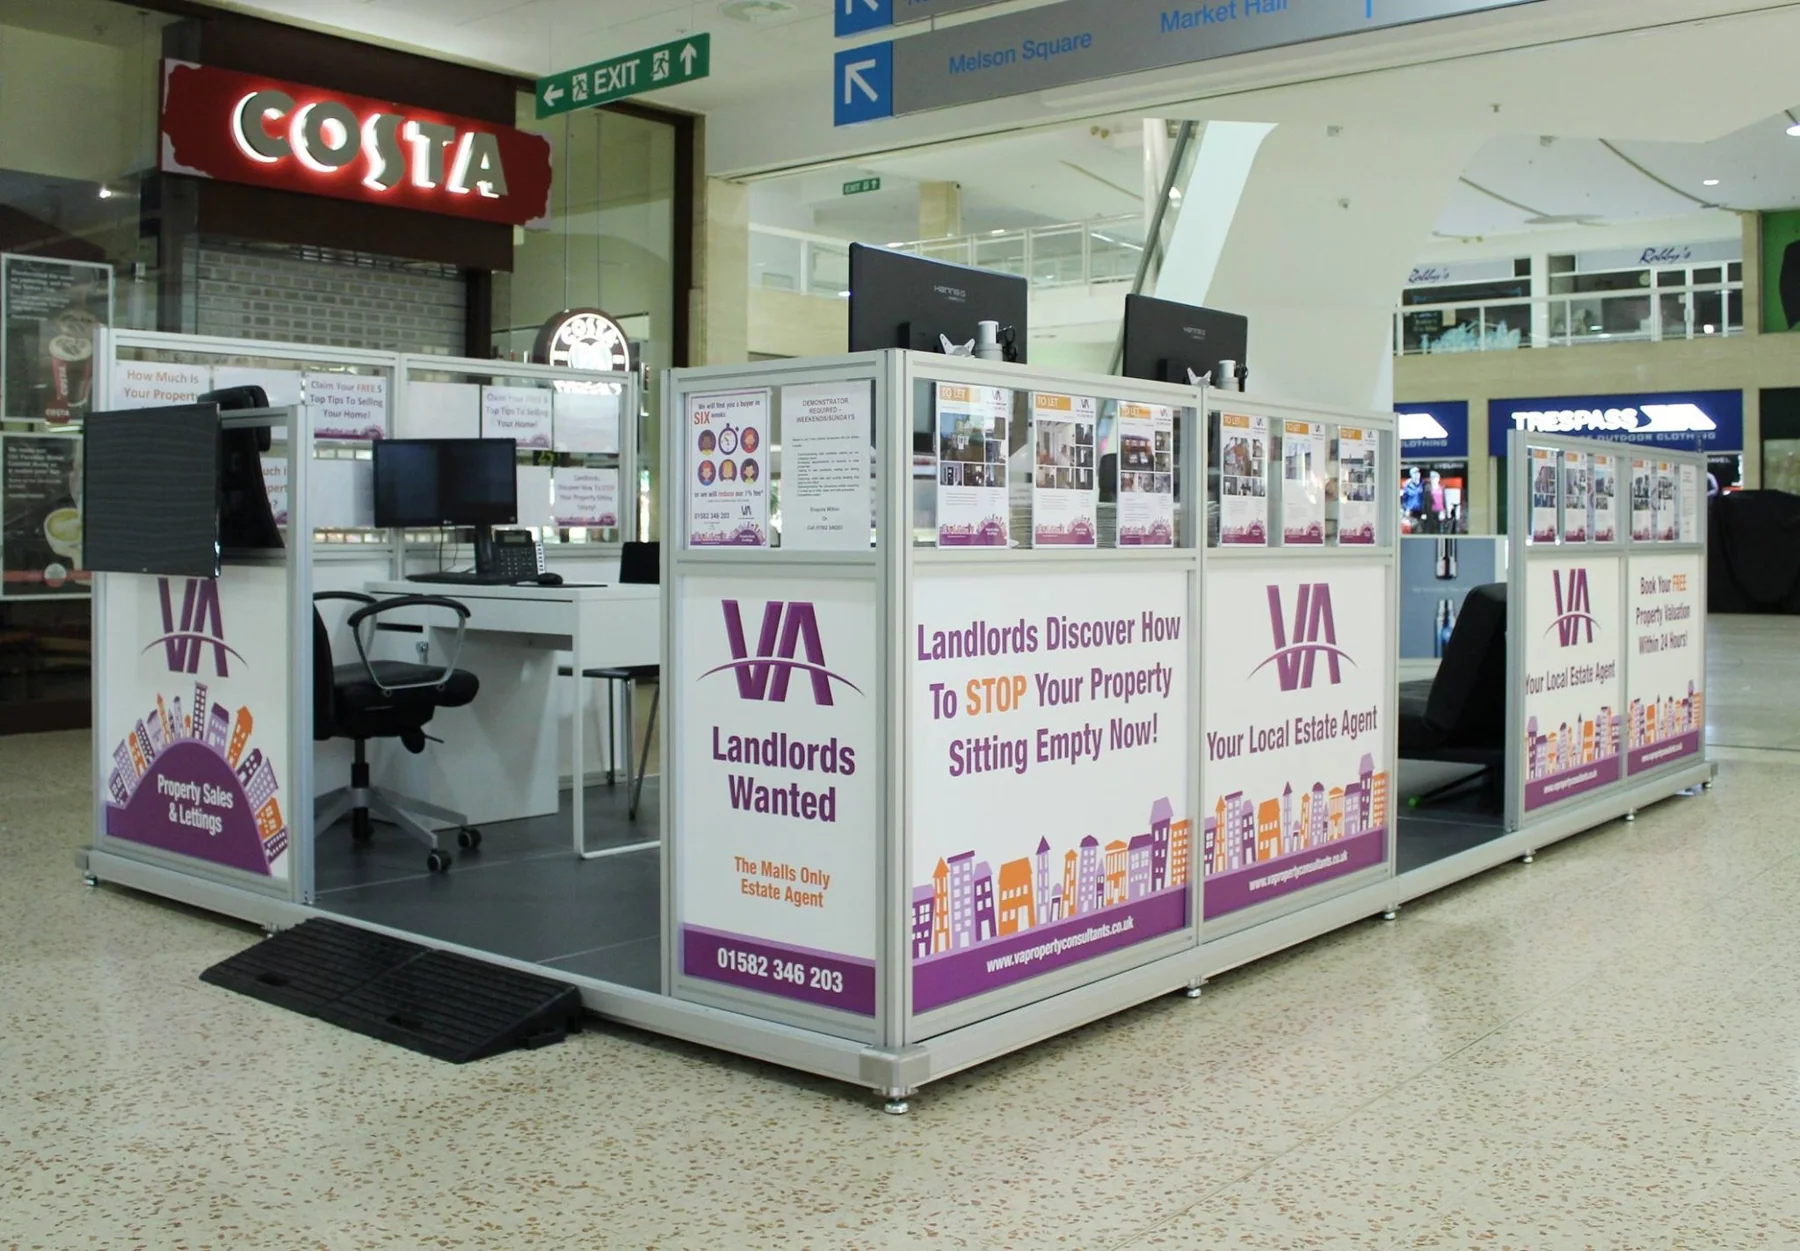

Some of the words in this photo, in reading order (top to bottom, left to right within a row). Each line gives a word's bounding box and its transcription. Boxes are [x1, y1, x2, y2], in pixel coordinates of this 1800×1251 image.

[1160, 2, 1237, 33] Market
[949, 47, 1016, 75] Melson
[1022, 32, 1092, 61] Square
[594, 59, 640, 95] EXIT
[231, 88, 509, 199] COSTA
[124, 387, 151, 399] Your
[127, 369, 153, 381] How
[156, 371, 187, 383] Much
[190, 373, 199, 384] Is
[311, 380, 333, 390] Claim
[336, 382, 354, 391] Your
[357, 384, 375, 393] FREE
[310, 395, 325, 405] Top
[328, 395, 344, 405] Tips
[346, 396, 356, 405] To
[358, 397, 383, 408] Selling
[323, 409, 341, 418] Your
[694, 411, 710, 425] SIX
[796, 413, 856, 423] WEEKENDS/SUNDAYS
[802, 397, 849, 407] DEMONSTRATOR
[809, 406, 837, 415] REQUIRED
[1511, 407, 1638, 432] TRESPASS
[262, 466, 281, 477] uch
[1640, 576, 1656, 595] Book
[1658, 576, 1671, 593] Your
[1672, 574, 1687, 592] FREE
[1553, 568, 1593, 647] VA
[1636, 605, 1663, 627] Property
[1664, 603, 1690, 620] Valuation
[721, 599, 834, 706] VA
[917, 618, 1038, 661] Landlords
[1046, 616, 1135, 651] Discover
[1142, 611, 1181, 643] How
[1266, 583, 1341, 692] VA
[1639, 636, 1659, 655] Within
[1660, 636, 1669, 651] 24
[1670, 633, 1688, 649] Hours!
[929, 682, 958, 720] To
[966, 674, 1027, 716] STOP
[1035, 671, 1083, 707] Your
[1090, 661, 1173, 704] Property
[1526, 673, 1544, 695] Your
[1547, 667, 1568, 691] Local
[1570, 665, 1593, 686] Estate
[1596, 659, 1615, 684] Agent
[712, 725, 856, 776] Landlords
[948, 735, 1028, 777] Sitting
[1036, 723, 1102, 765] Empty
[1110, 712, 1158, 751] Now!
[1207, 730, 1244, 761] Your
[1249, 719, 1289, 754] Local
[1295, 714, 1337, 745] Estate
[1341, 705, 1378, 740] Agent
[157, 773, 201, 804] Property
[203, 782, 234, 810] Sales
[728, 774, 836, 823] Wanted
[168, 802, 178, 823] &
[179, 804, 223, 836] Lettings
[734, 856, 757, 876] The
[761, 861, 797, 882] Malls
[800, 866, 830, 891] Only
[1249, 850, 1348, 892] www.vapropertyconsultants.co.uk
[740, 877, 781, 900] Estate
[784, 885, 824, 909] Agent
[986, 915, 1134, 973] www.vapropertyconsultants.co.uk
[717, 947, 768, 979] 01582
[773, 958, 805, 986] 346
[810, 966, 843, 994] 203
